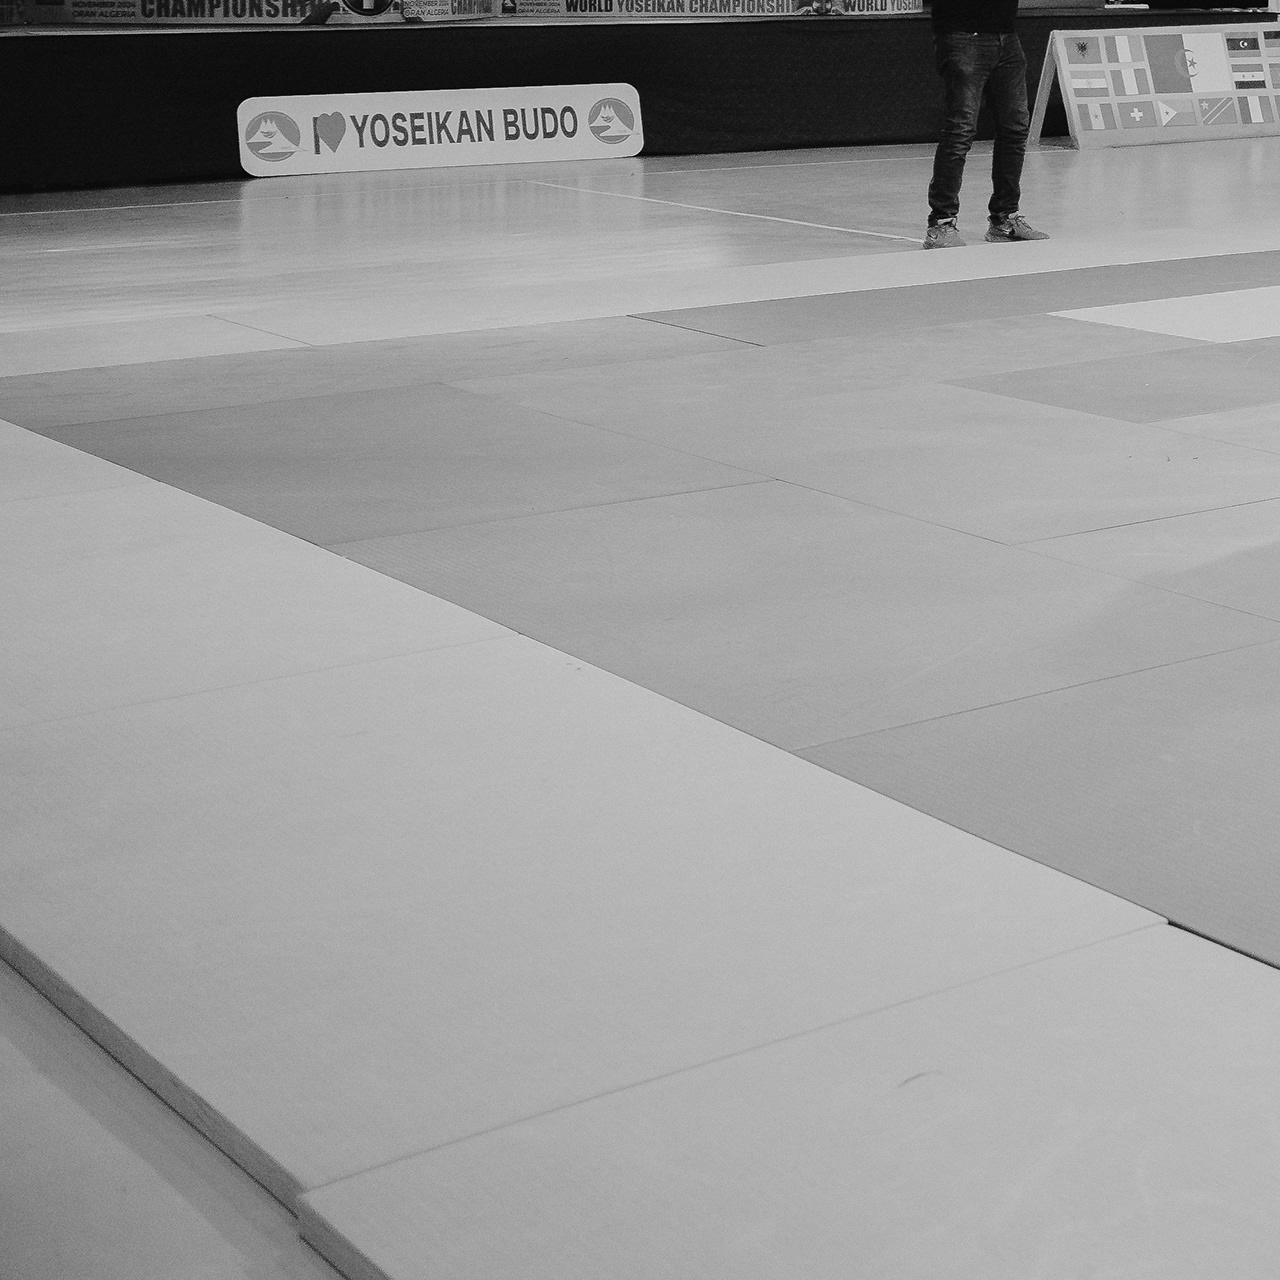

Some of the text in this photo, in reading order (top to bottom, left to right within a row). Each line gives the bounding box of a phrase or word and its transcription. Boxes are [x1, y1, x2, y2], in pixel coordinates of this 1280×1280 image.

[71, 10, 136, 18] ORAN ALGERIA
[404, 9, 425, 17] ORAN
[312, 105, 579, 155] I YOSEIKAN BUDO
